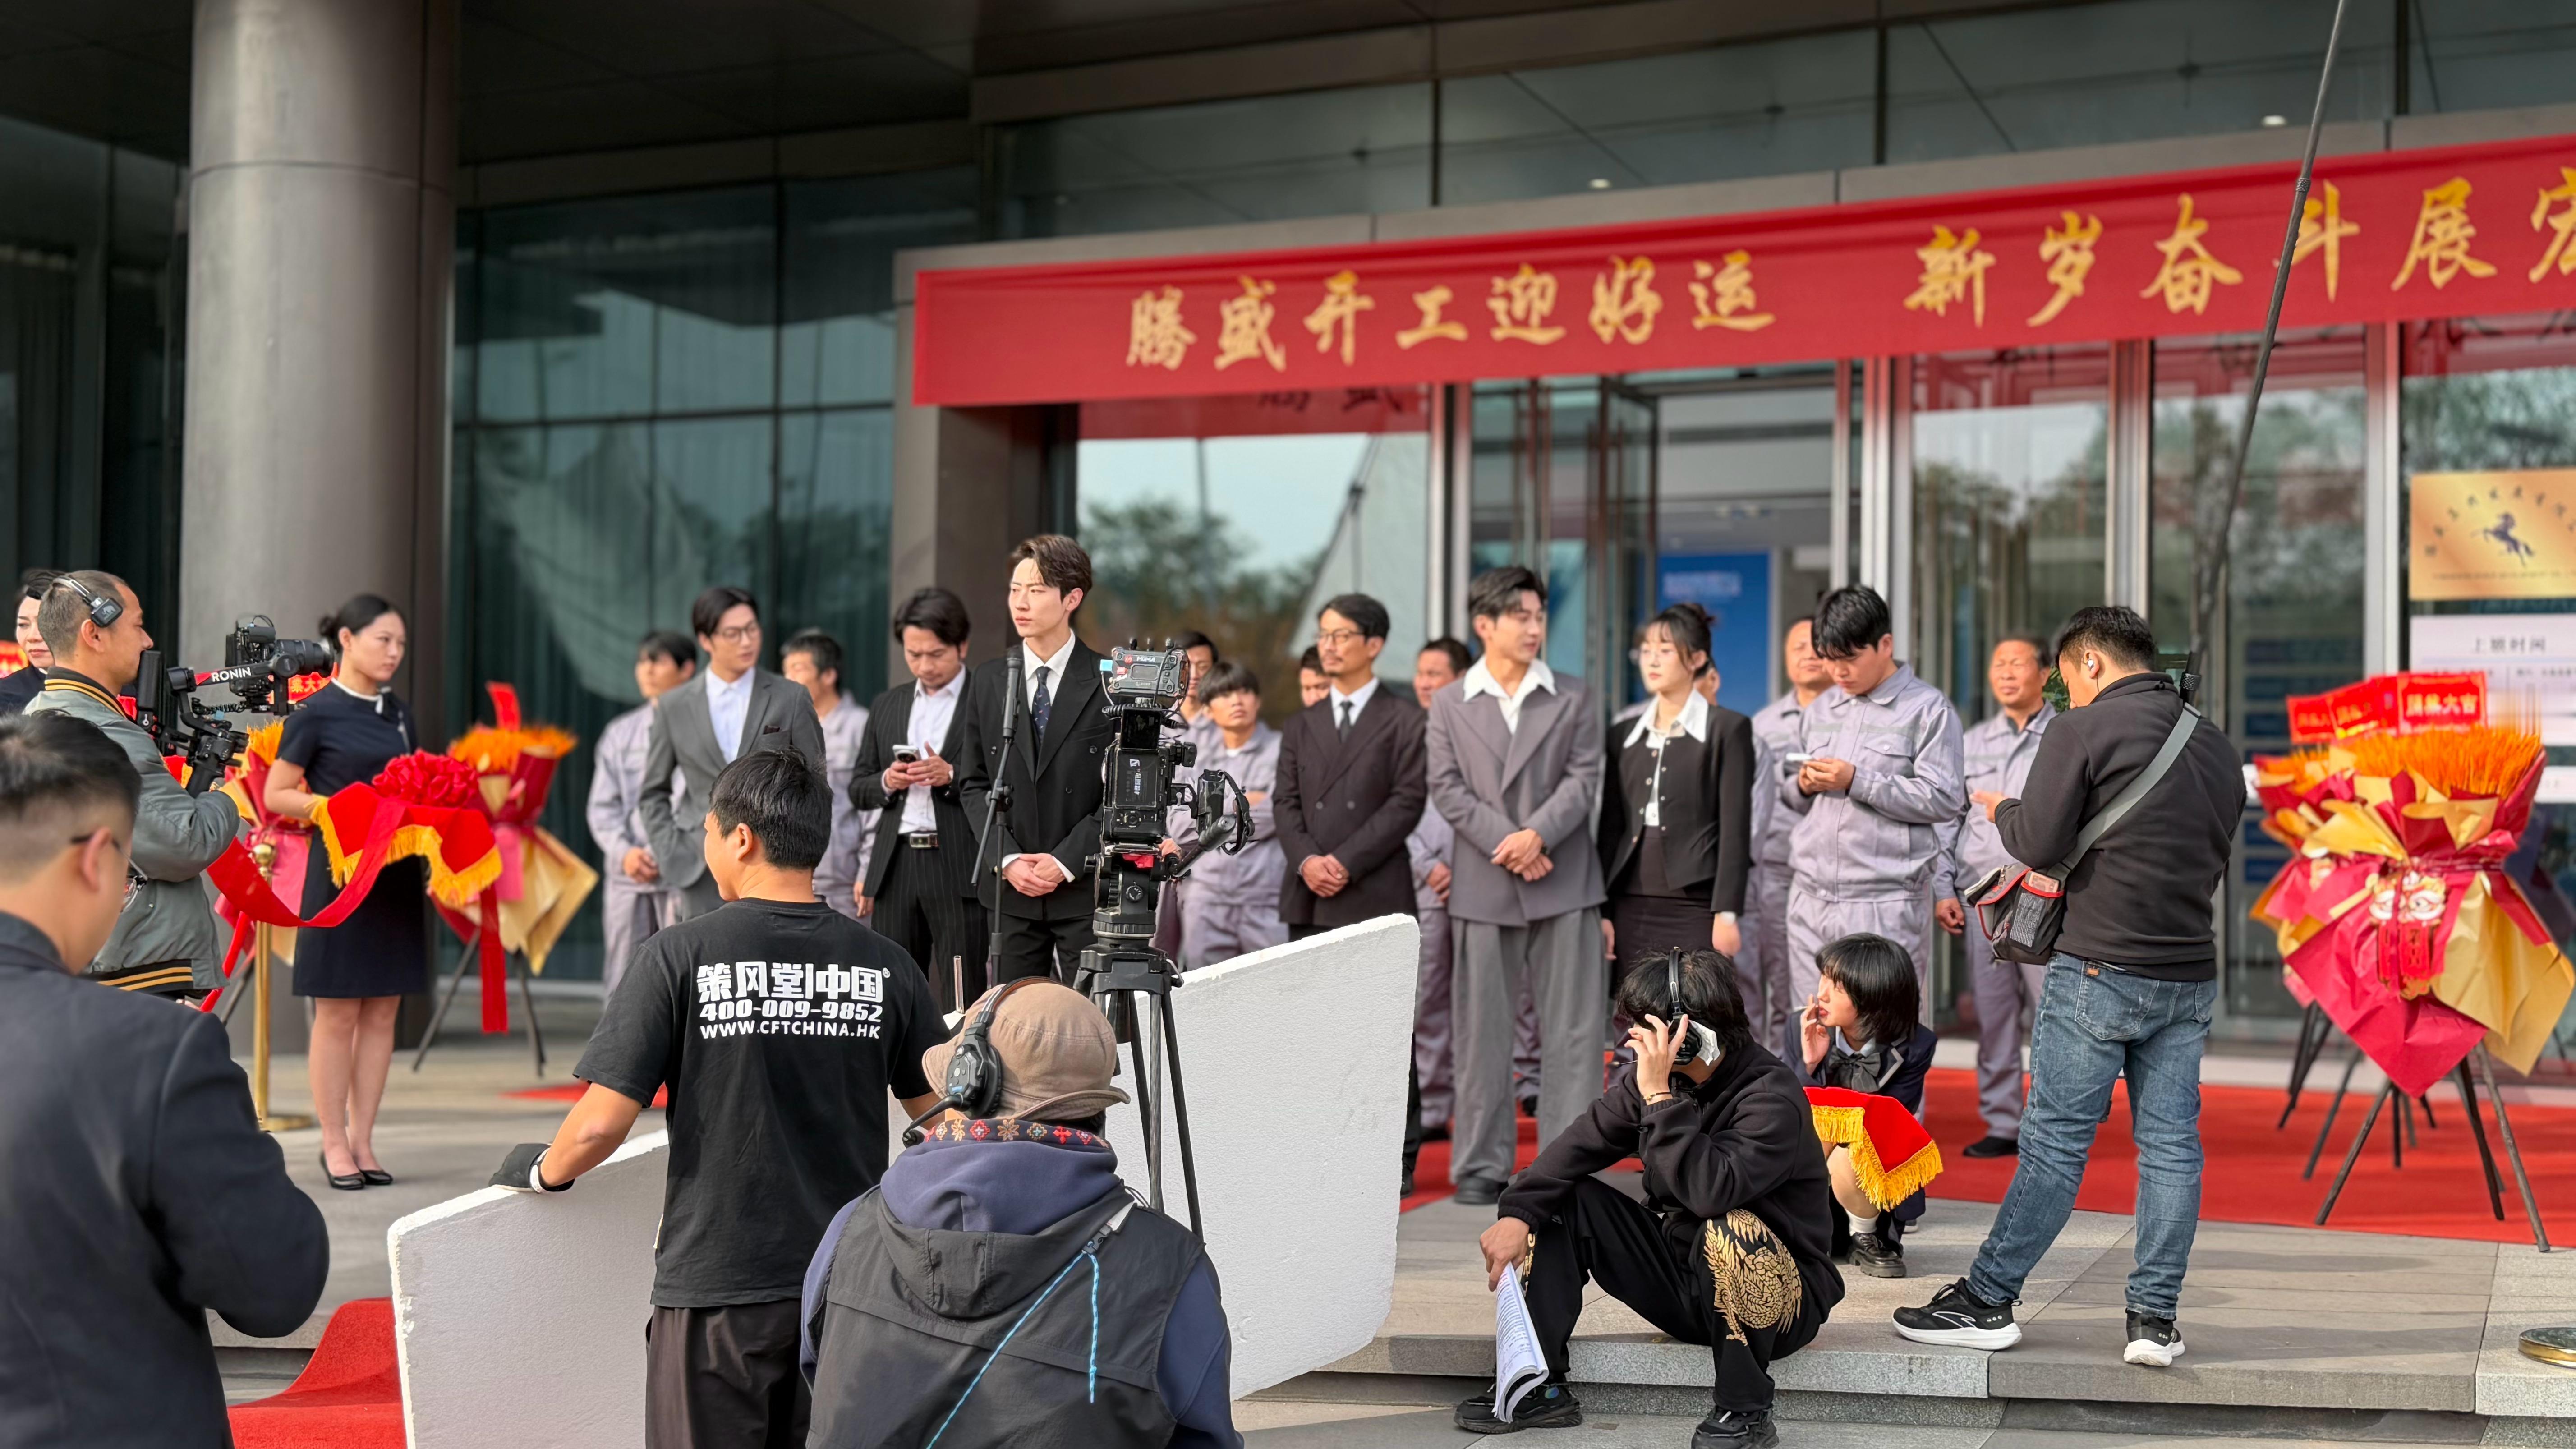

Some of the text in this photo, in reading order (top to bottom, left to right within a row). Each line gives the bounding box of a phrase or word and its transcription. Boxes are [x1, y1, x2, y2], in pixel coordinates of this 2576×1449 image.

[211, 667, 251, 682] RONIN
[699, 999, 883, 1022] 400-009-9852
[700, 1020, 881, 1039] WWW.CFTCHINA.HK
